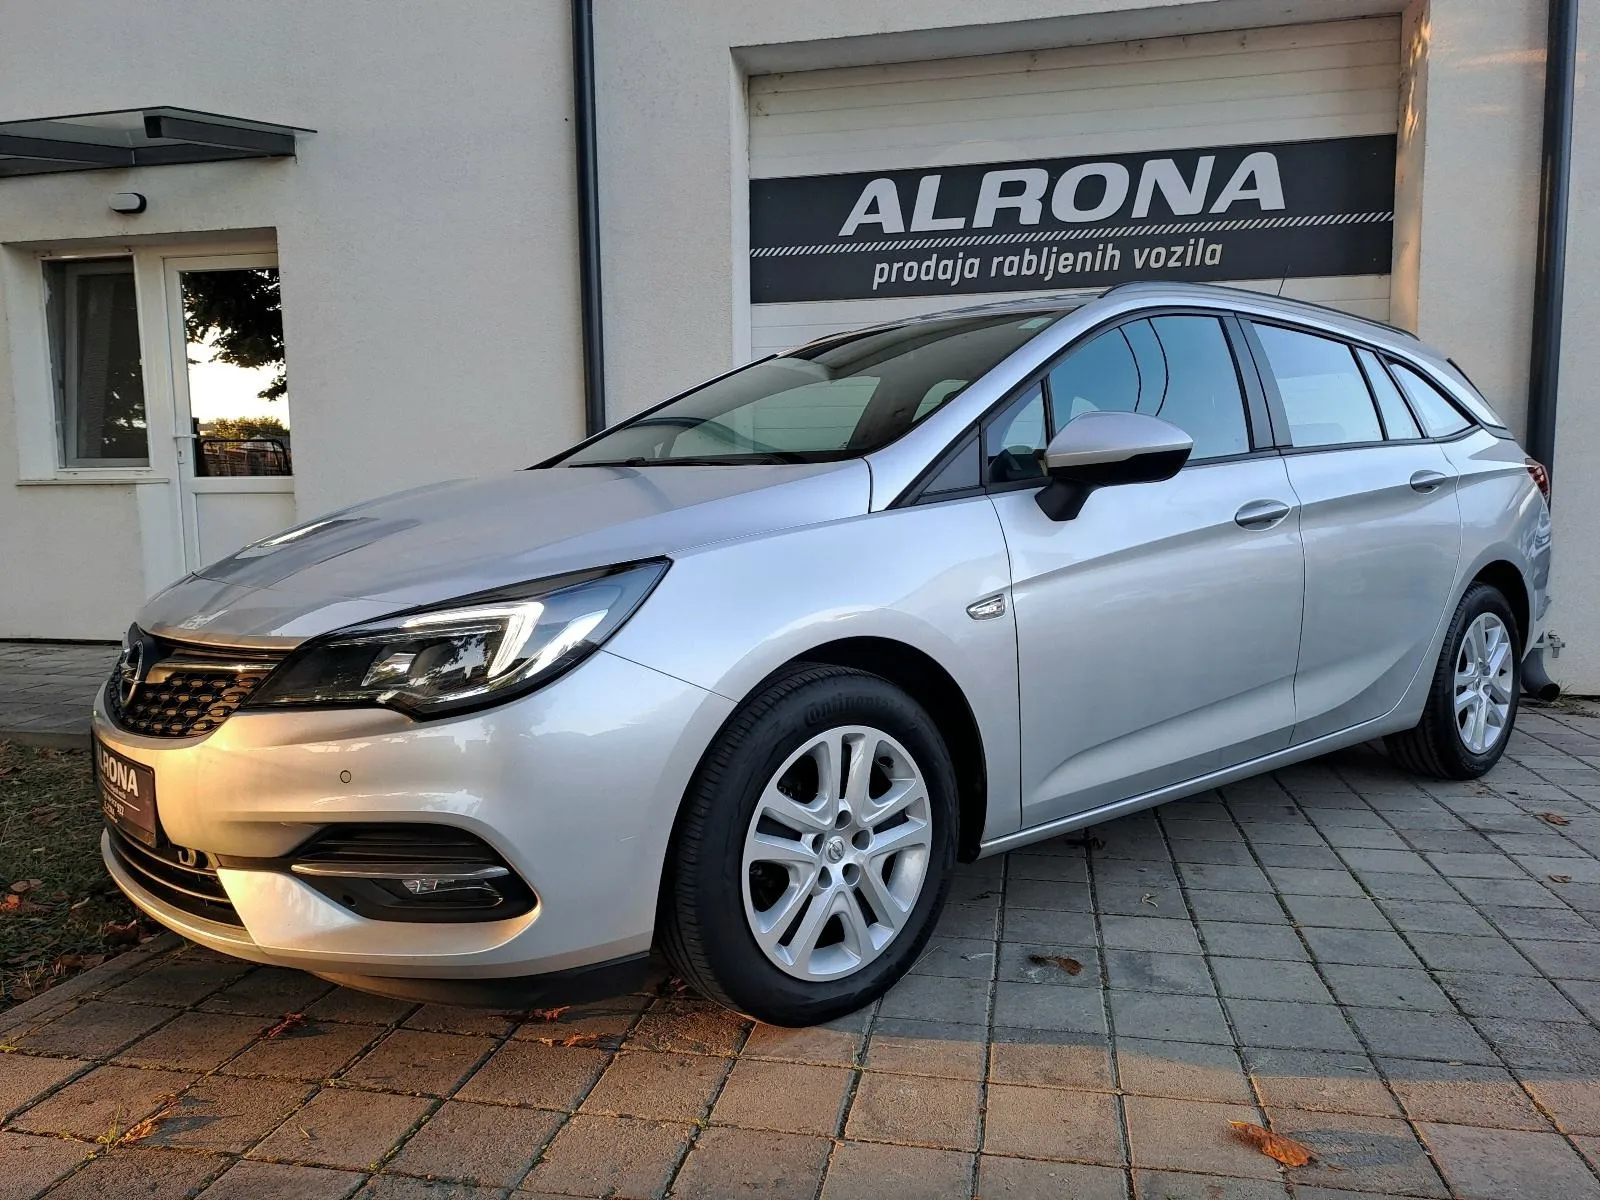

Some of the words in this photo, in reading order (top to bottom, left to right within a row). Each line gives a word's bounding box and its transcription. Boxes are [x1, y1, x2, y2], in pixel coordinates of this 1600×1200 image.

[839, 151, 1286, 237] ALRONA
[872, 252, 981, 291] prodaja
[990, 243, 1121, 281] rabljenih
[1133, 237, 1223, 270] vozila
